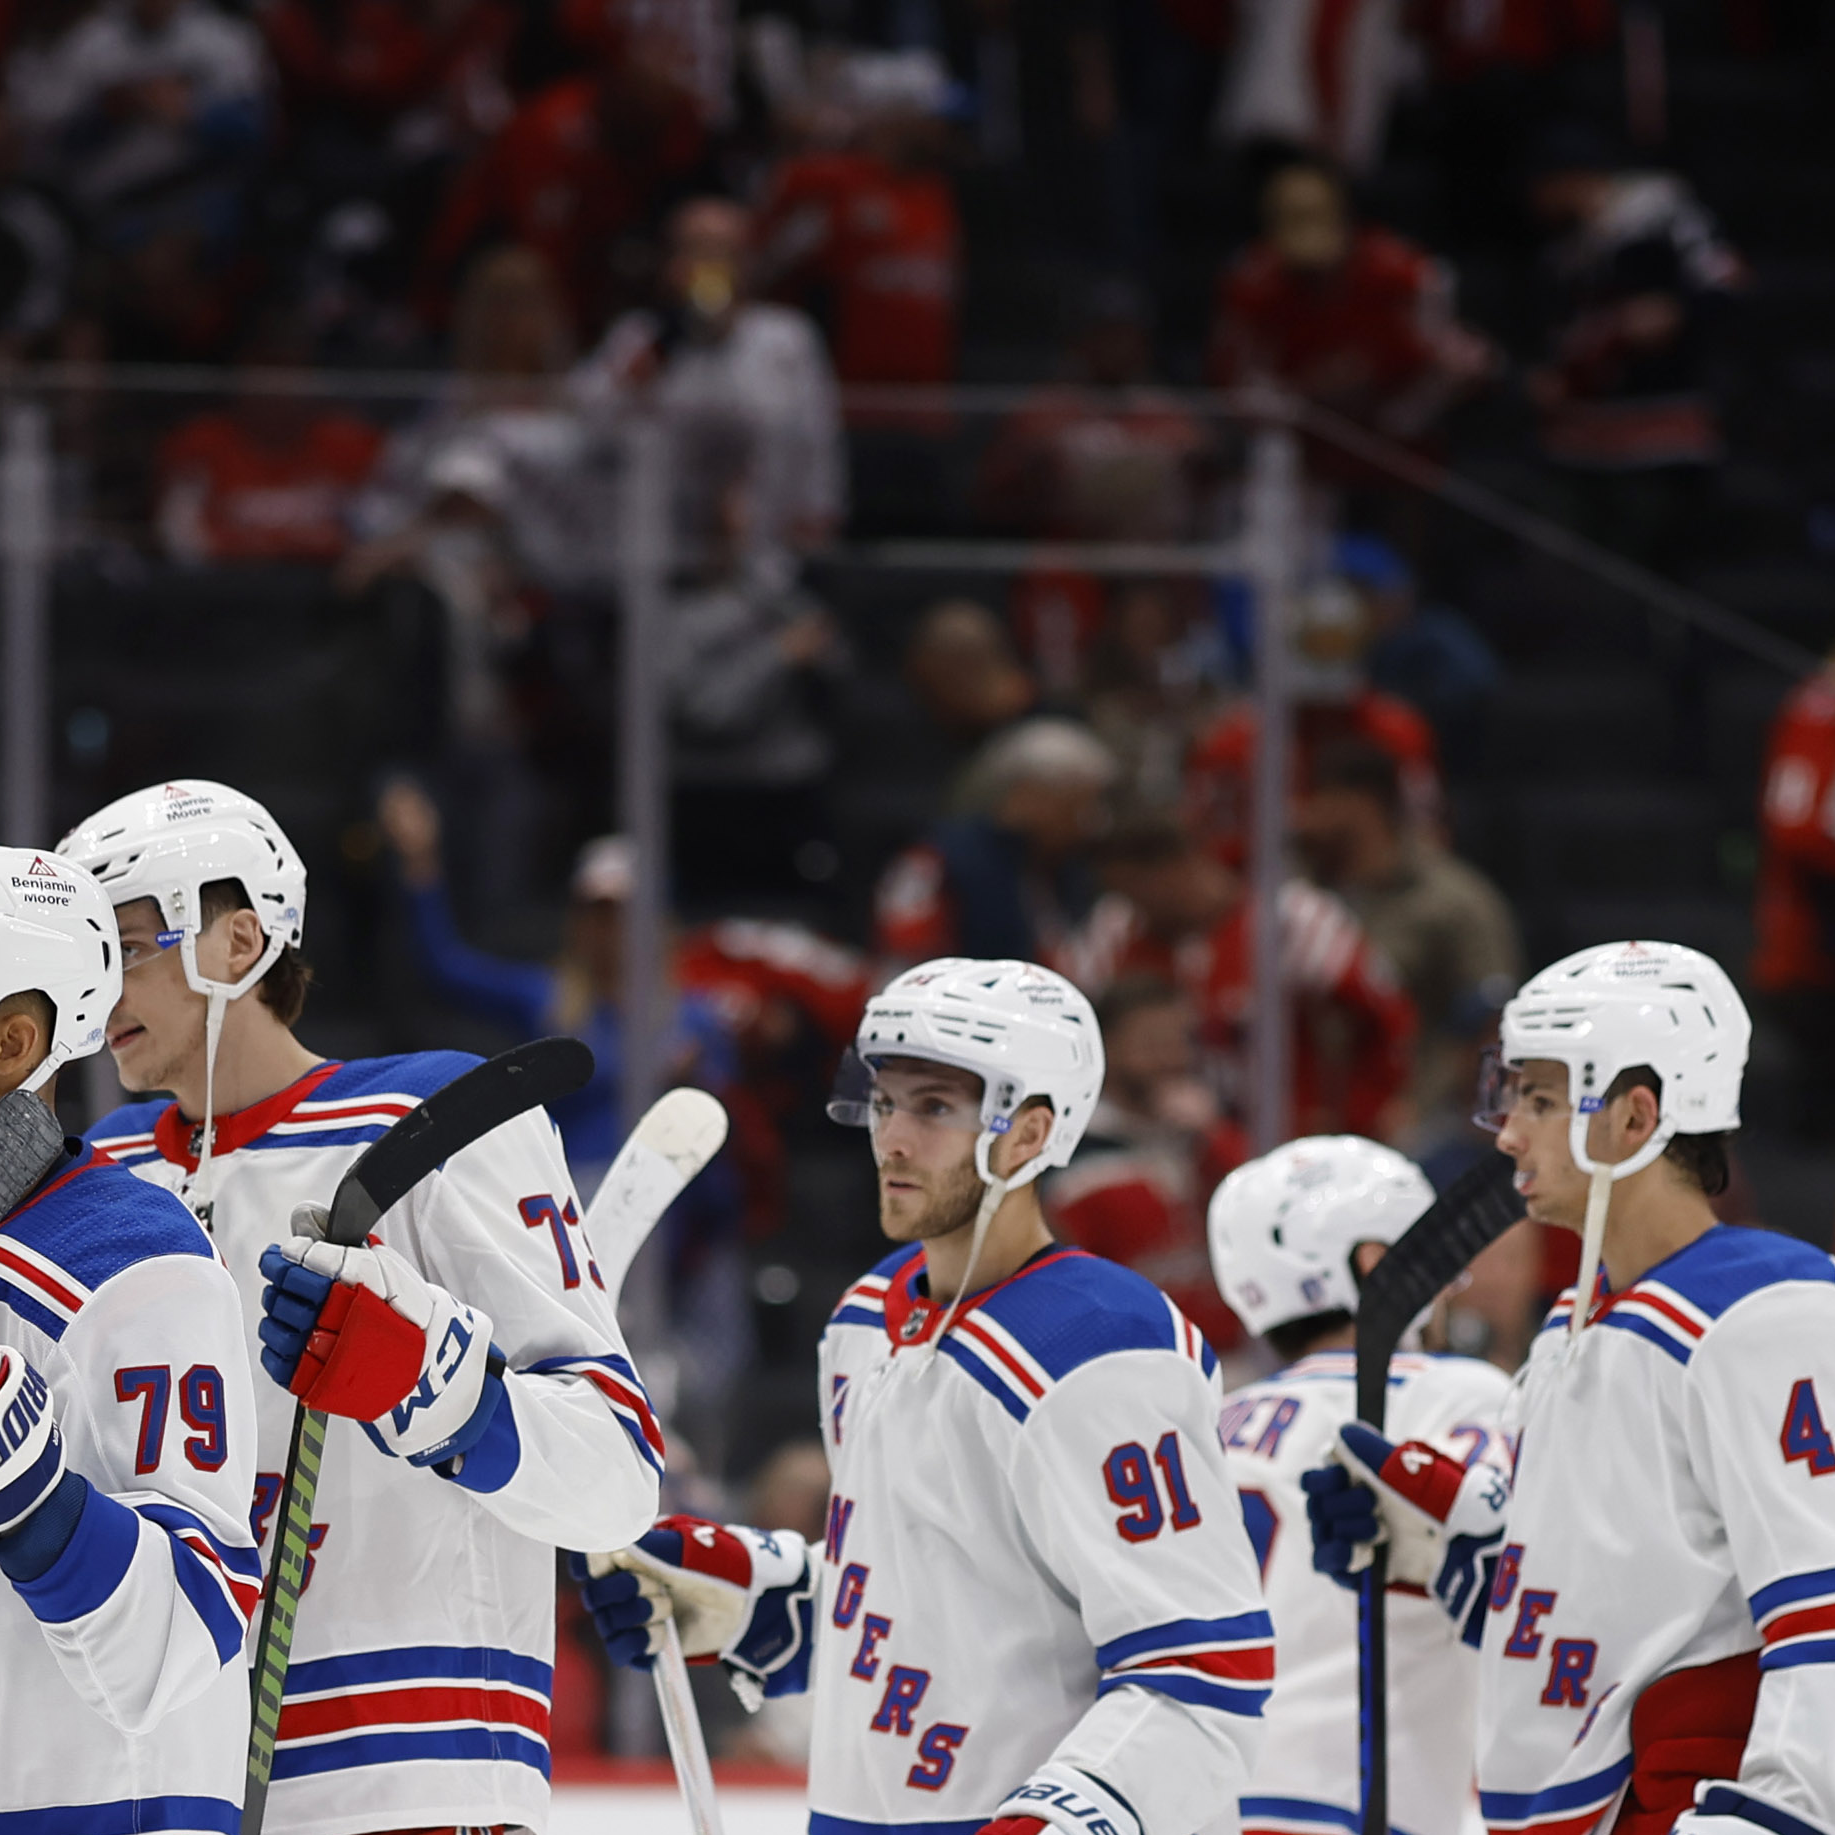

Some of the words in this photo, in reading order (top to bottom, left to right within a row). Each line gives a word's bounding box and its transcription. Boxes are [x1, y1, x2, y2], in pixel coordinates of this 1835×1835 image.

[157, 795, 214, 811] njamin
[11, 877, 77, 895] Benjamin
[23, 893, 70, 907] Moore
[114, 1363, 229, 1476] 79
[1102, 1430, 1202, 1544] 91
